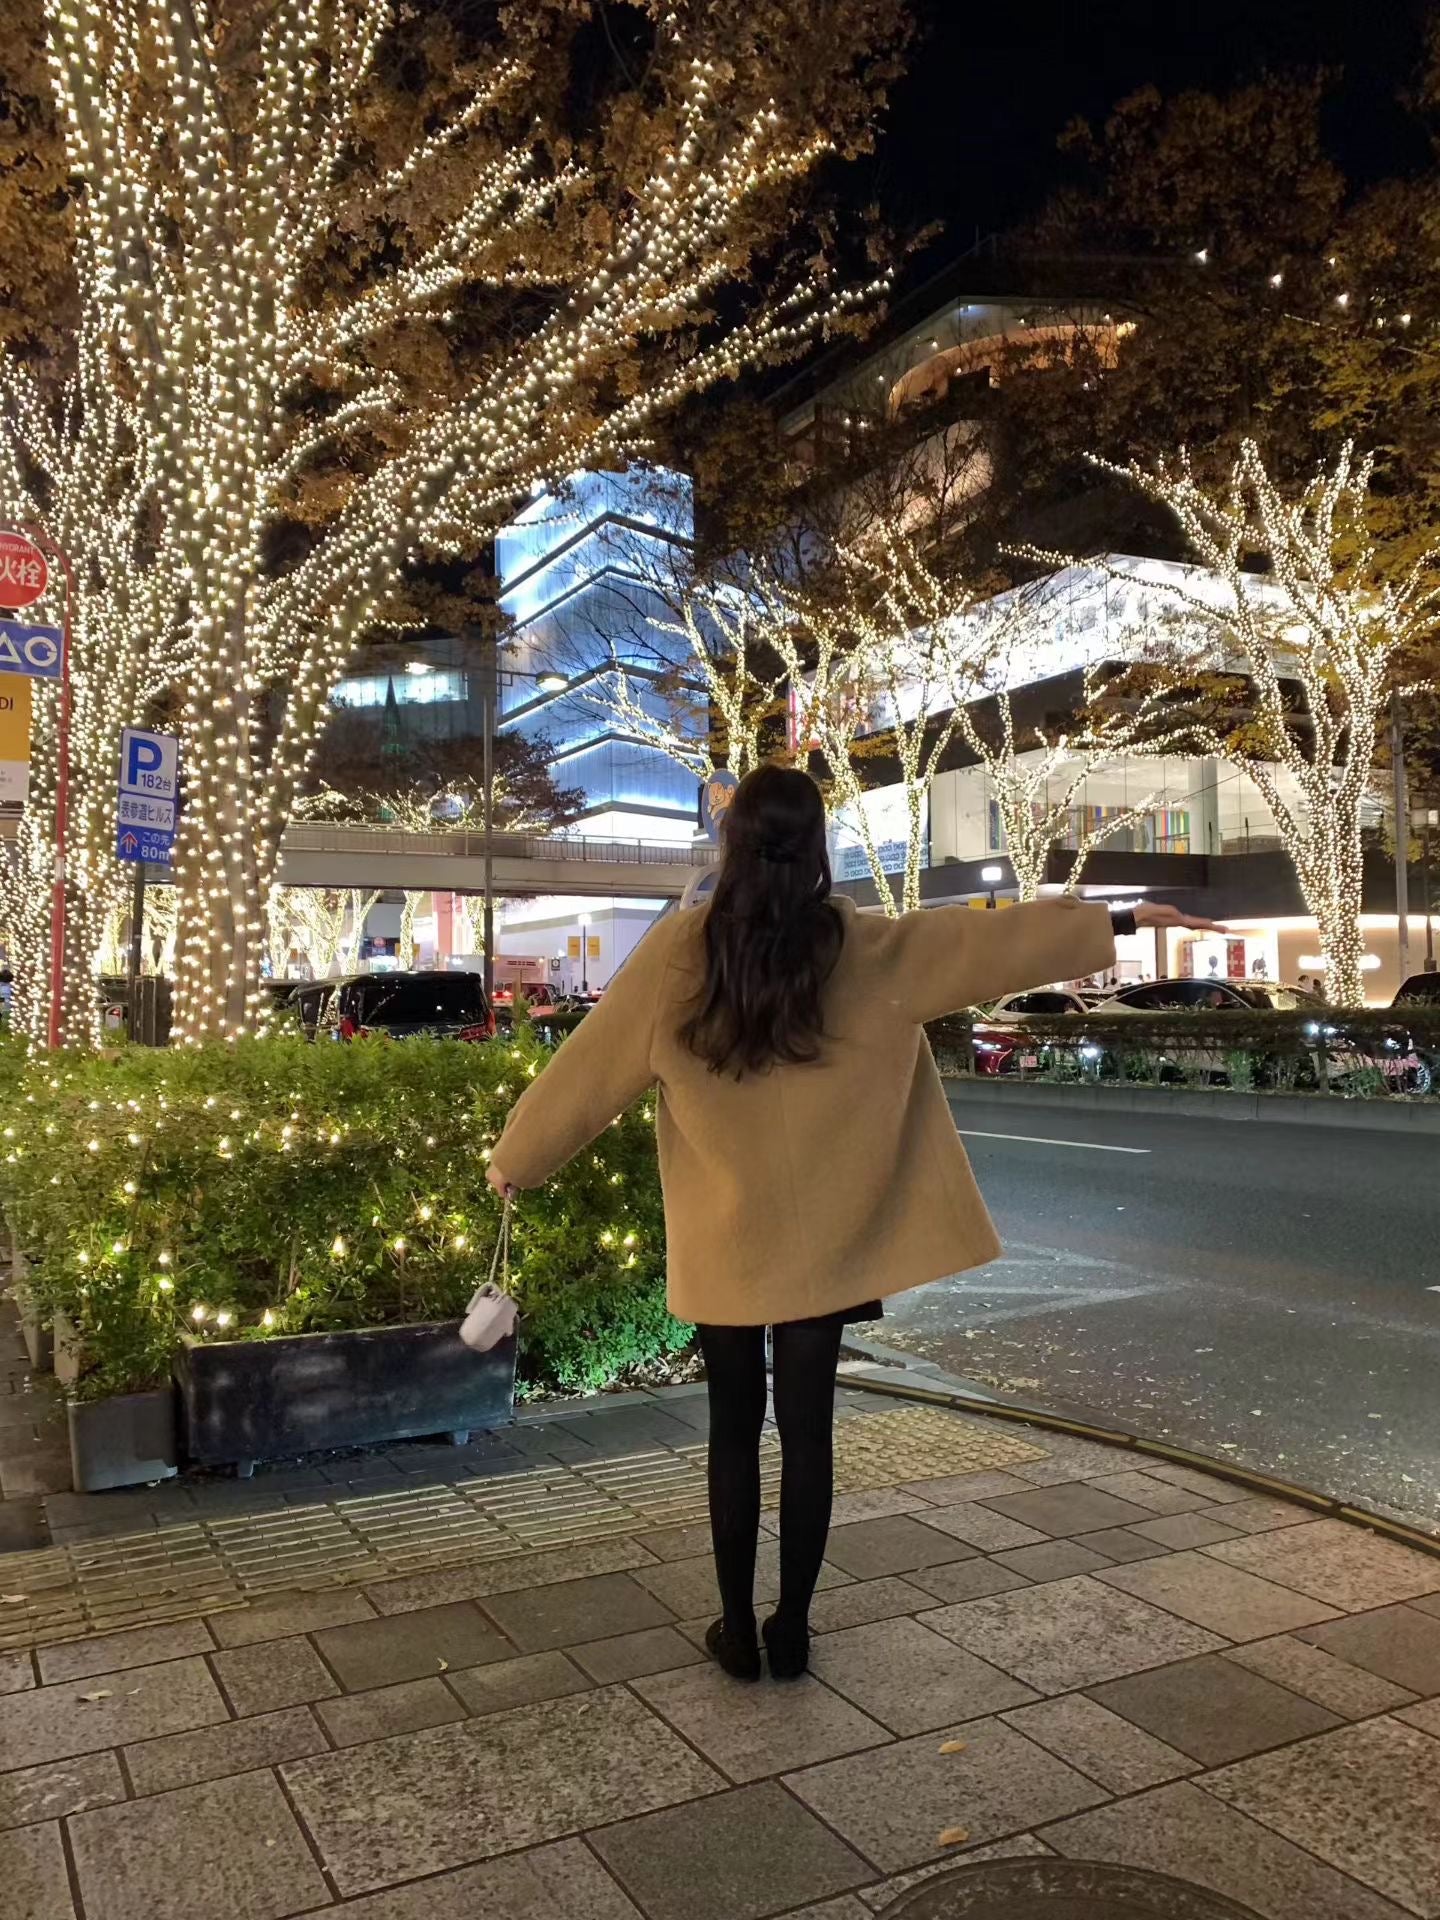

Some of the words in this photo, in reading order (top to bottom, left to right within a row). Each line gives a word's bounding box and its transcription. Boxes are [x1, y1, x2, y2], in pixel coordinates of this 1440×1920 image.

[128, 736, 162, 785] P
[141, 773, 172, 792] 182台
[140, 845, 169, 861] 80m
